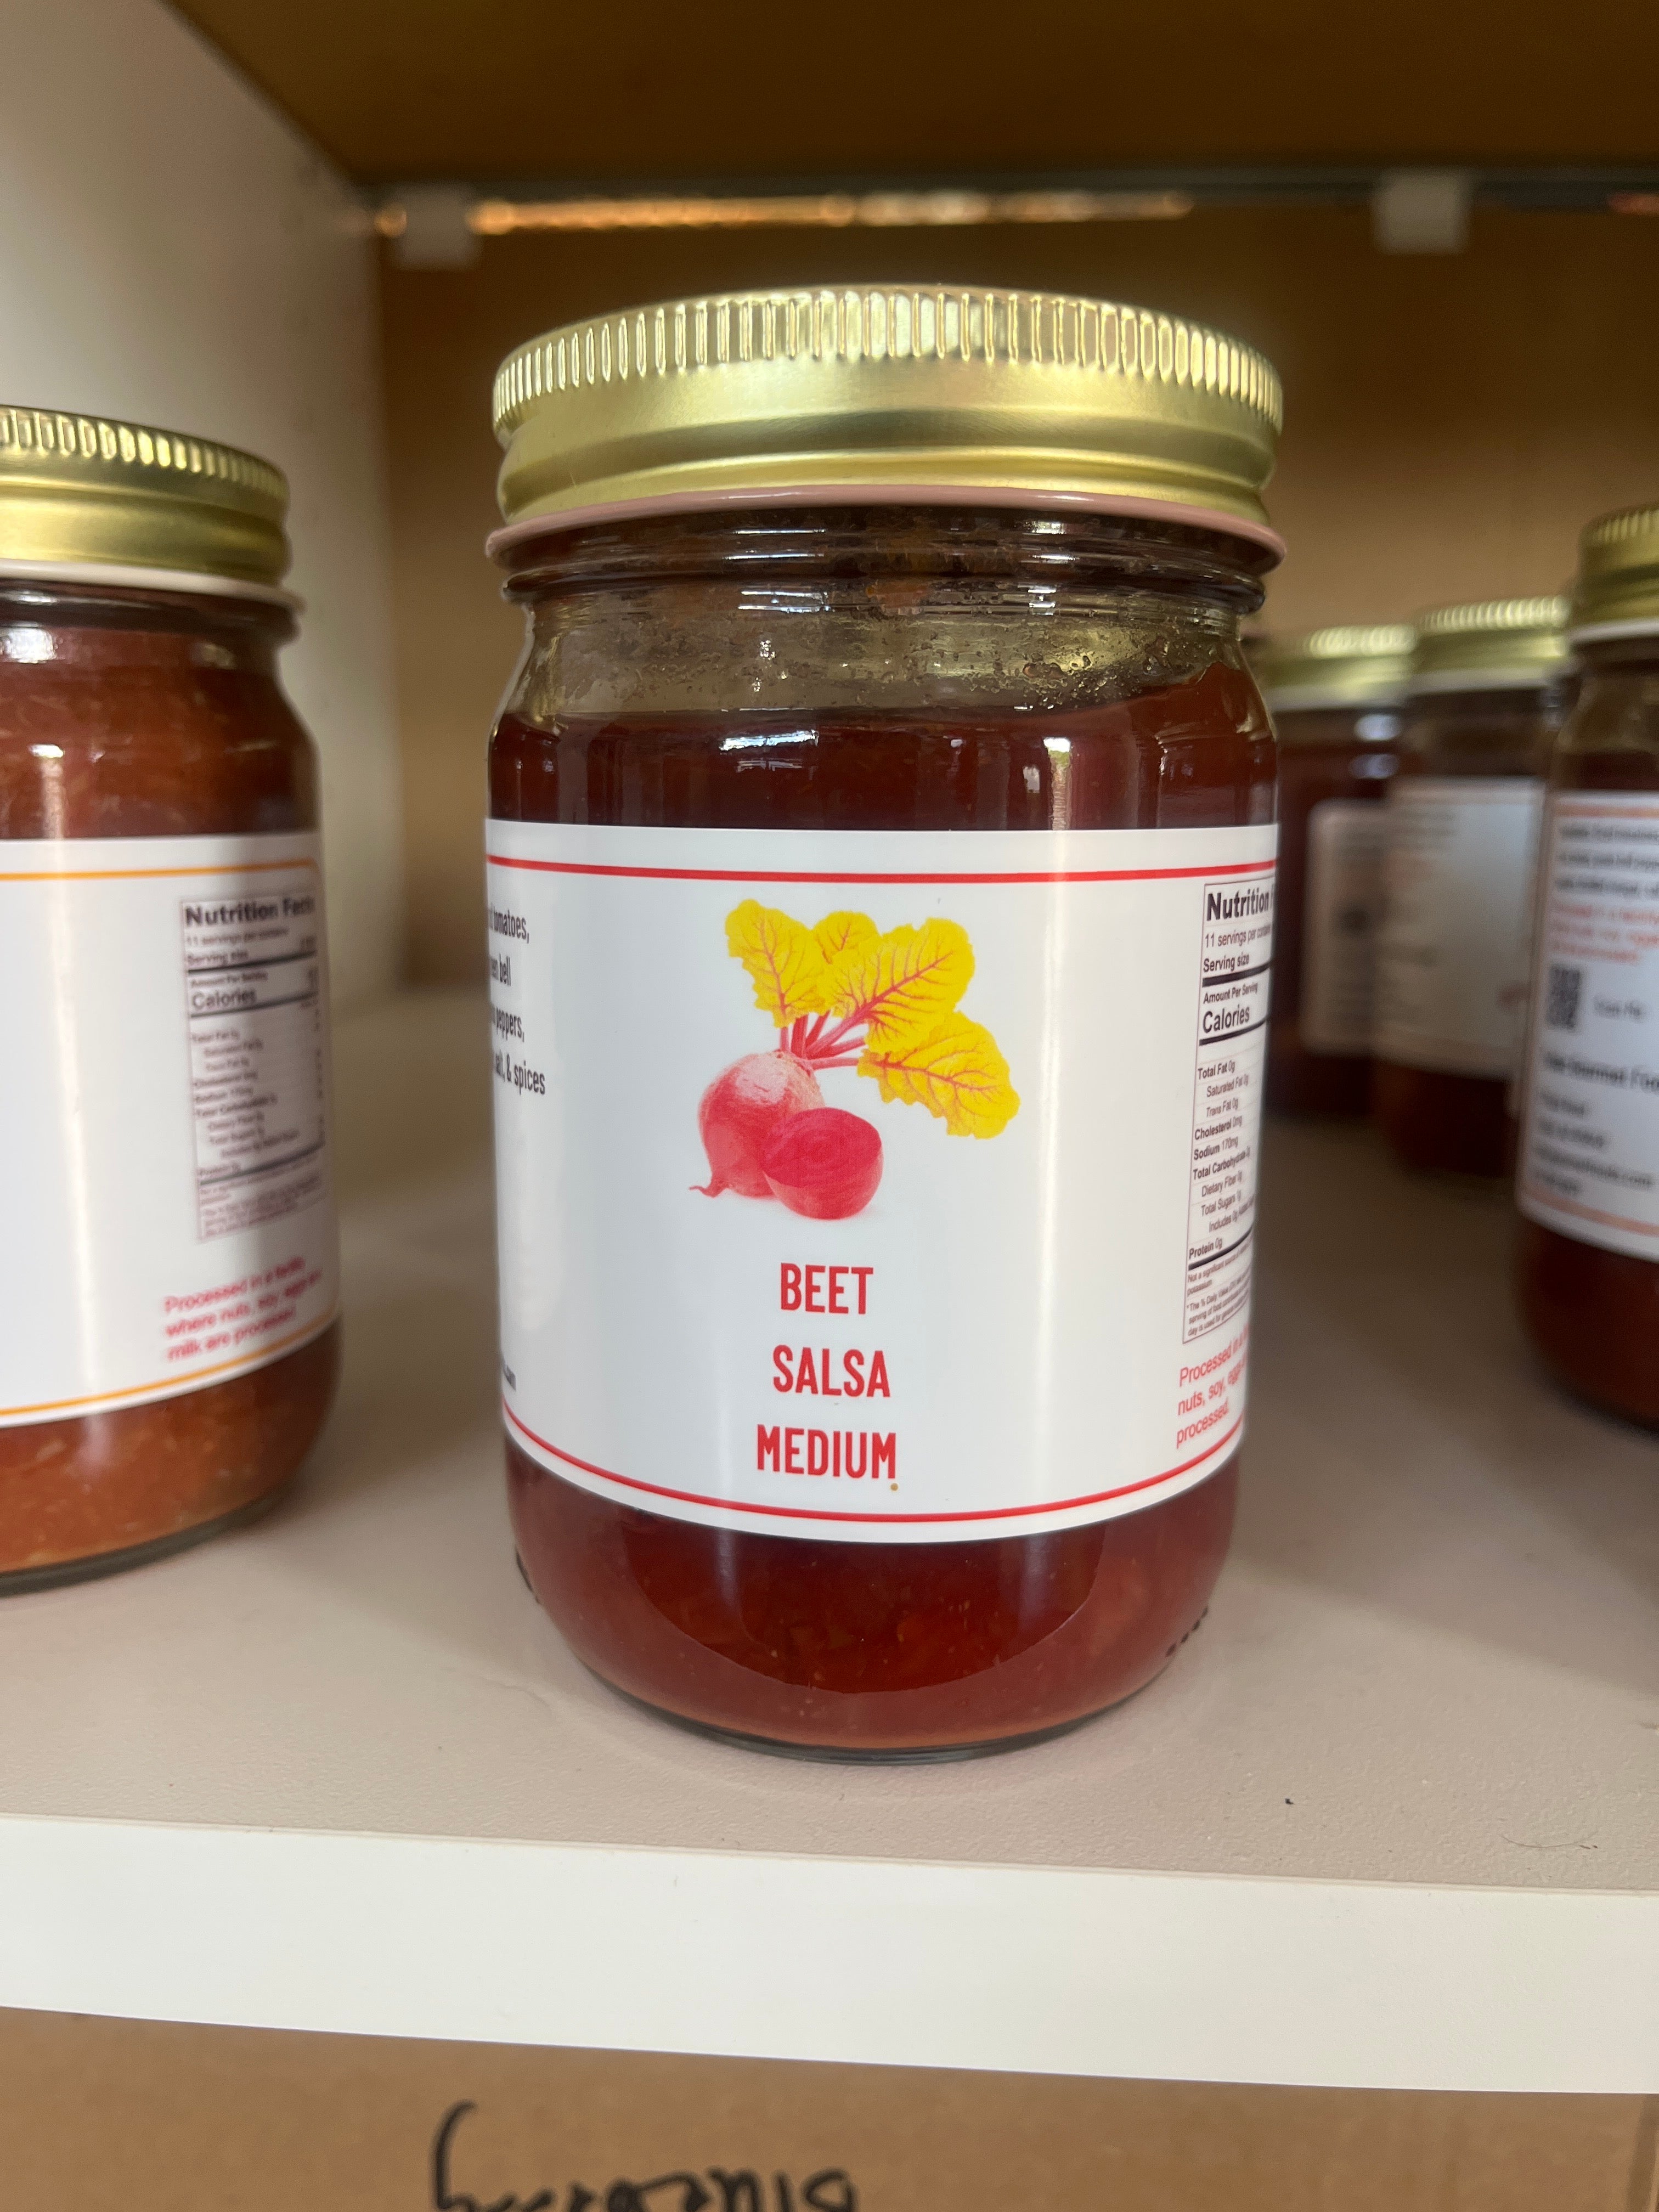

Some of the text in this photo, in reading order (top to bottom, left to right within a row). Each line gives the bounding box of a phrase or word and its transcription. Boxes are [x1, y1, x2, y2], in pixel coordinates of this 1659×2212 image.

[186, 901, 278, 926] Nutrition
[1206, 889, 1269, 922] Nutrition
[1205, 933, 1214, 948] 11
[1217, 929, 1246, 946] servings
[499, 954, 511, 986] bell
[1203, 952, 1250, 973] Serving size
[192, 989, 255, 1009] Calories
[1203, 981, 1258, 1004] Amount Per Serving
[1203, 1005, 1250, 1034] Calories
[507, 1053, 512, 1082] &
[514, 1060, 545, 1095] spices
[1198, 1065, 1215, 1080] Total
[1217, 1063, 1227, 1075] Fat
[1207, 1080, 1234, 1097] Saturated
[1206, 1105, 1221, 1118] Trans
[1194, 1118, 1232, 1141] Cholesterol
[1193, 1143, 1220, 1160] Sodium
[1193, 1166, 1210, 1180] Total
[1201, 1178, 1223, 1197] Dietary
[1201, 1200, 1216, 1216] Total
[1189, 1241, 1214, 1260] Protein
[781, 1262, 874, 1314] BEET
[773, 1344, 891, 1398] SALSA
[1179, 1341, 1232, 1387] Processed
[1178, 1391, 1205, 1415] nuts,
[757, 1424, 896, 1479] MEDIUM
